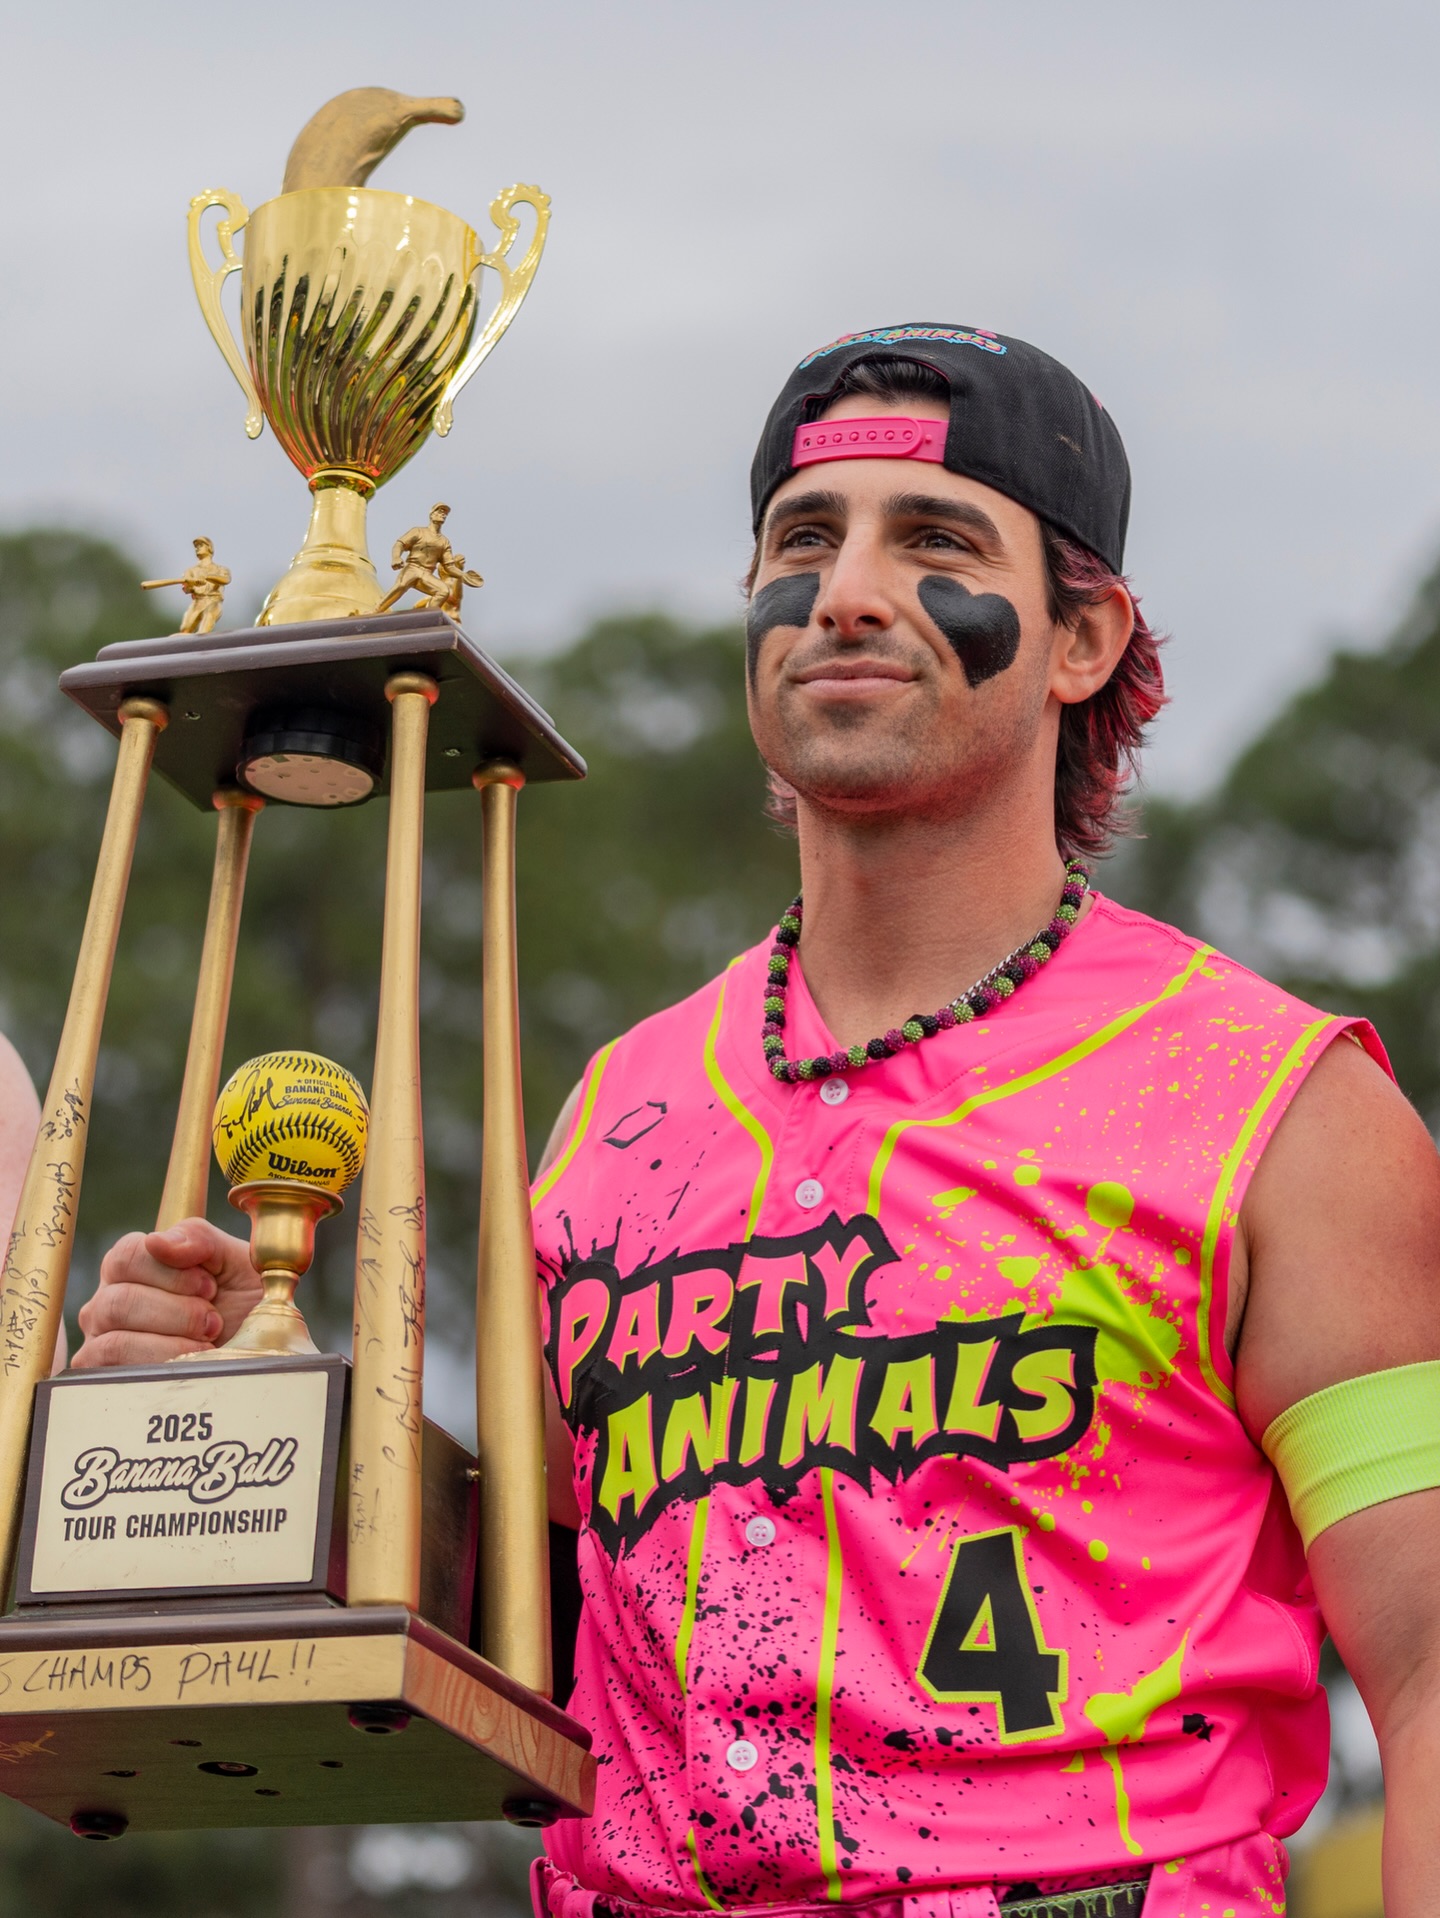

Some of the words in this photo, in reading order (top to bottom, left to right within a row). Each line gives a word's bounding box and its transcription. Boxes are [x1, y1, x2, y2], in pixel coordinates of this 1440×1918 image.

[285, 1085, 325, 1095] BANANA
[330, 1089, 348, 1103] BALL
[305, 1078, 334, 1088] OFFICIAL
[268, 1151, 338, 1178] Wilson
[556, 1233, 874, 1411] PARTY
[146, 1412, 213, 1444] 2025
[599, 1335, 1079, 1523] ANIMALS
[61, 1446, 200, 1510] Banana
[189, 1437, 298, 1504] Ball
[63, 1515, 117, 1542] TOUR
[126, 1508, 288, 1539] CHAMPIONSHIP
[915, 1524, 1069, 1745] 4
[23, 1655, 152, 1692] CHAMPS
